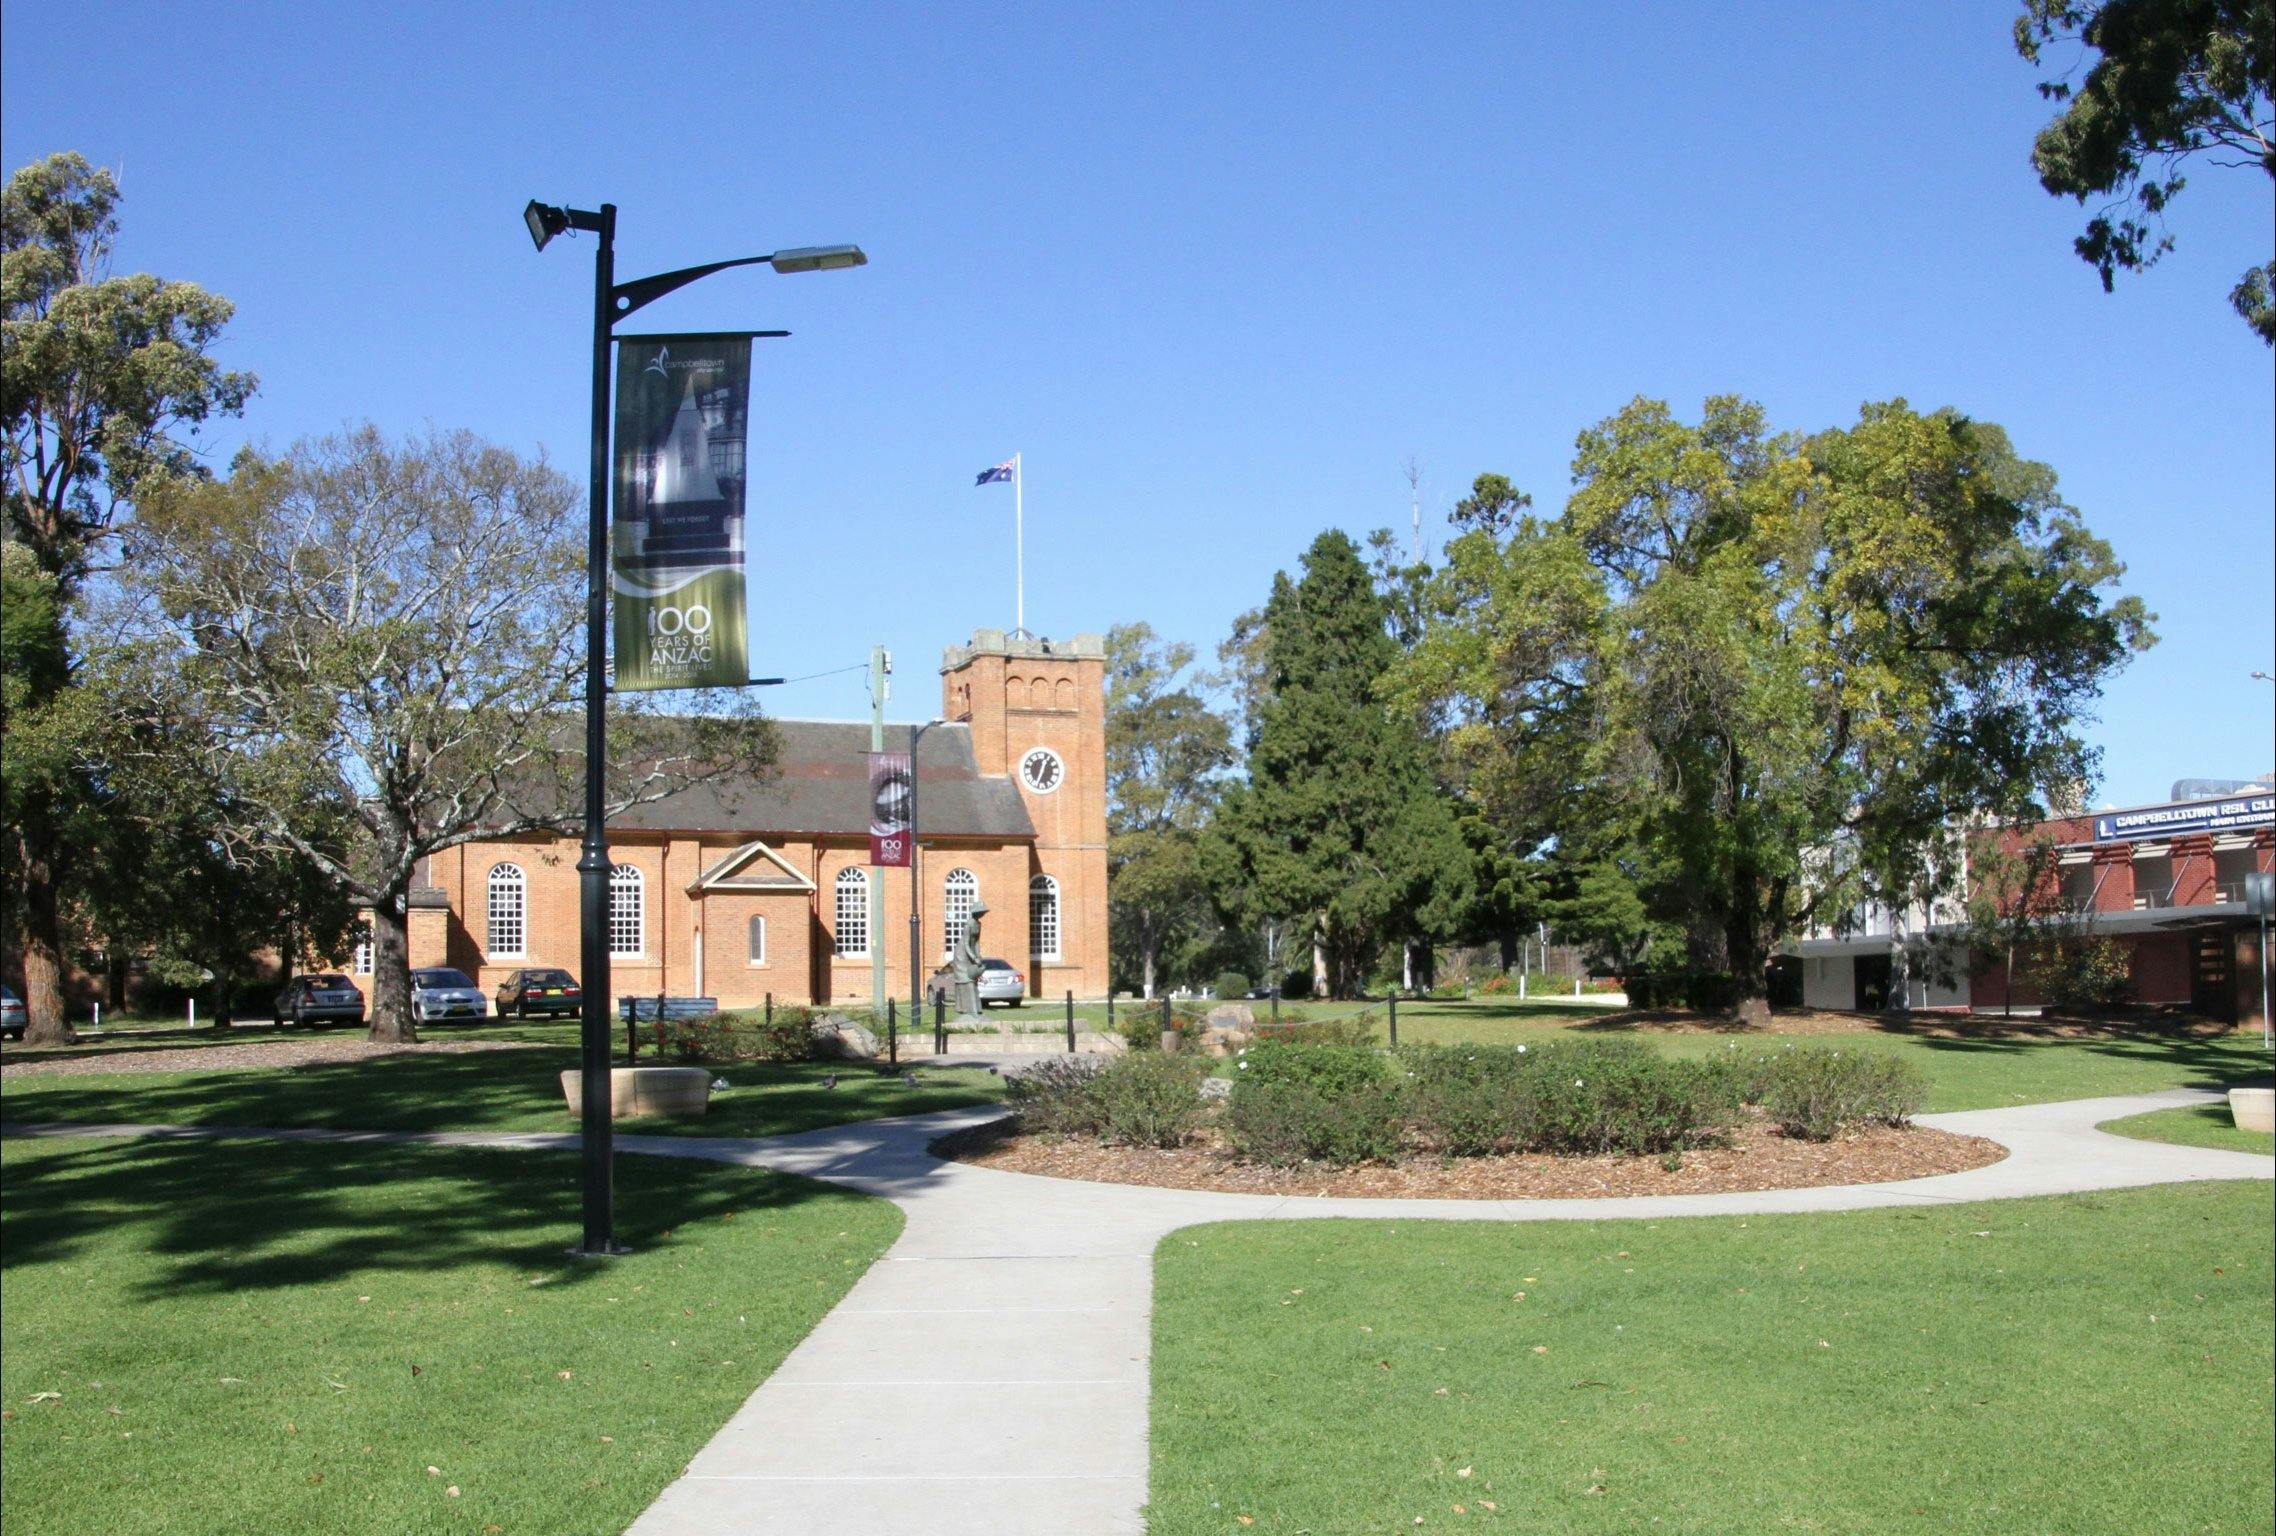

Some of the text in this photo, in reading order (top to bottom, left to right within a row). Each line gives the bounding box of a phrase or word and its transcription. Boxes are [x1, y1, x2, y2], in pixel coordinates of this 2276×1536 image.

[648, 605, 711, 636] 100
[649, 634, 711, 648] YEARS OF
[650, 646, 713, 665] ANZAC
[2116, 806, 2218, 828] CAMPBELLTOWN
[2221, 802, 2249, 816] RSL
